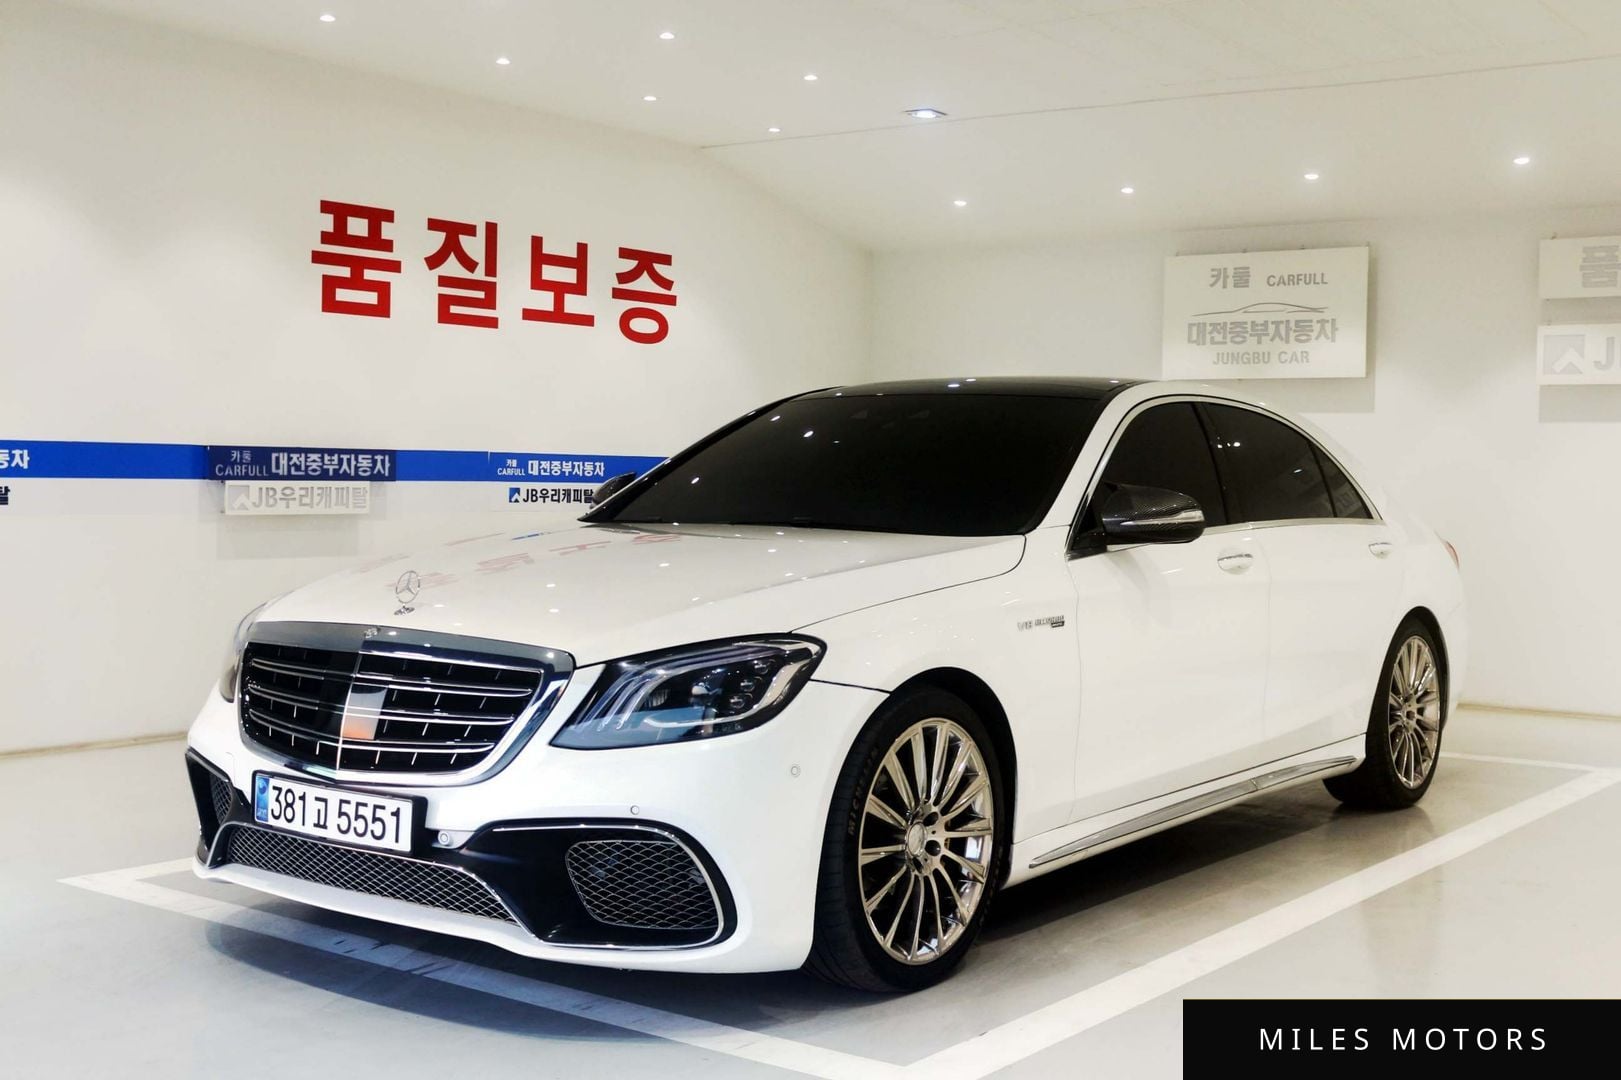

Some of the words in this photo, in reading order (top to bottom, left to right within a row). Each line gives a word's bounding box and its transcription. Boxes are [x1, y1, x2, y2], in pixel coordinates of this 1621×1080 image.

[311, 200, 677, 344] 품질보증
[1266, 272, 1329, 287] CARFULL
[1187, 318, 1339, 346] 대전중부자동차
[1213, 351, 1271, 365] JUNGBU
[1278, 350, 1310, 364] CAR
[215, 463, 269, 477] CARFULL
[271, 453, 391, 477] 대전중부자동차
[497, 467, 525, 476] CARFULL
[527, 459, 605, 477] 대전중부자동차
[252, 486, 368, 510] JB우리캐피탈
[523, 487, 594, 504] JB우리캐피탈
